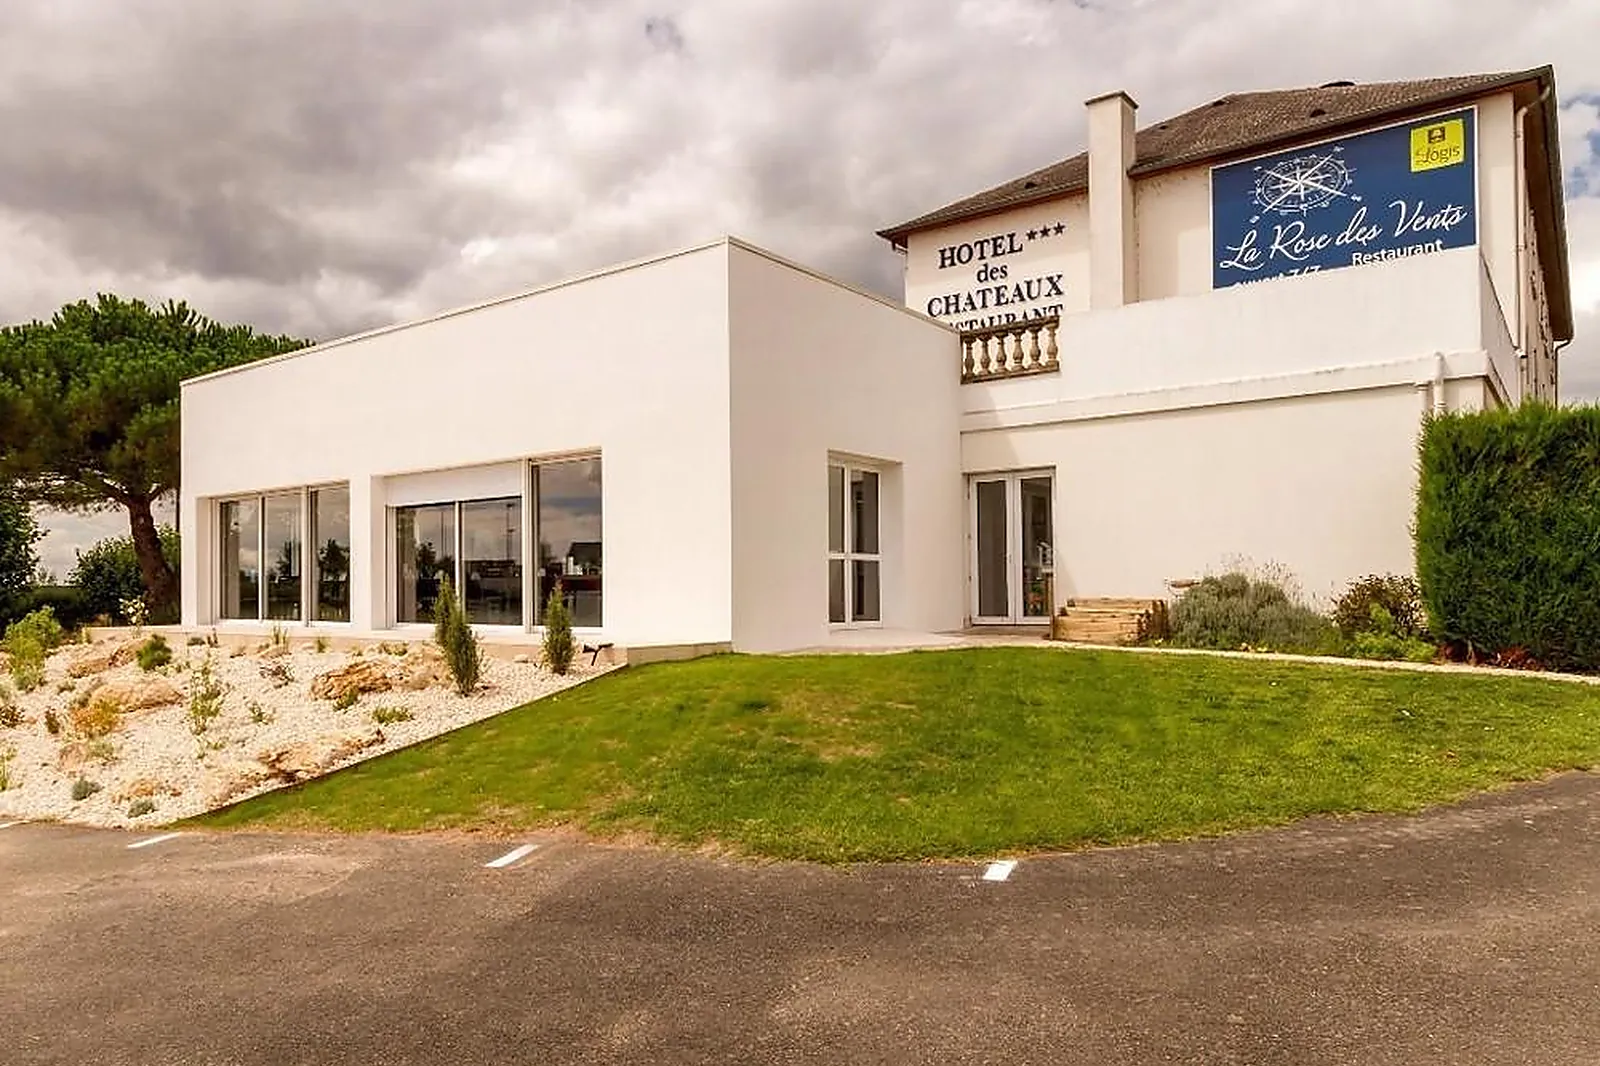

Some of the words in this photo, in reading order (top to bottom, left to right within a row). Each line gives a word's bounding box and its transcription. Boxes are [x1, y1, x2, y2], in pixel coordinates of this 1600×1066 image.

[938, 233, 1023, 269] HOTEL
[1220, 230, 1265, 270] La
[1270, 221, 1331, 260] Rose
[1336, 207, 1382, 246] des
[1389, 200, 1467, 238] Vents
[1352, 239, 1443, 266] Restaurant
[976, 263, 1008, 283] des
[927, 275, 1063, 317] CHATEAUX
